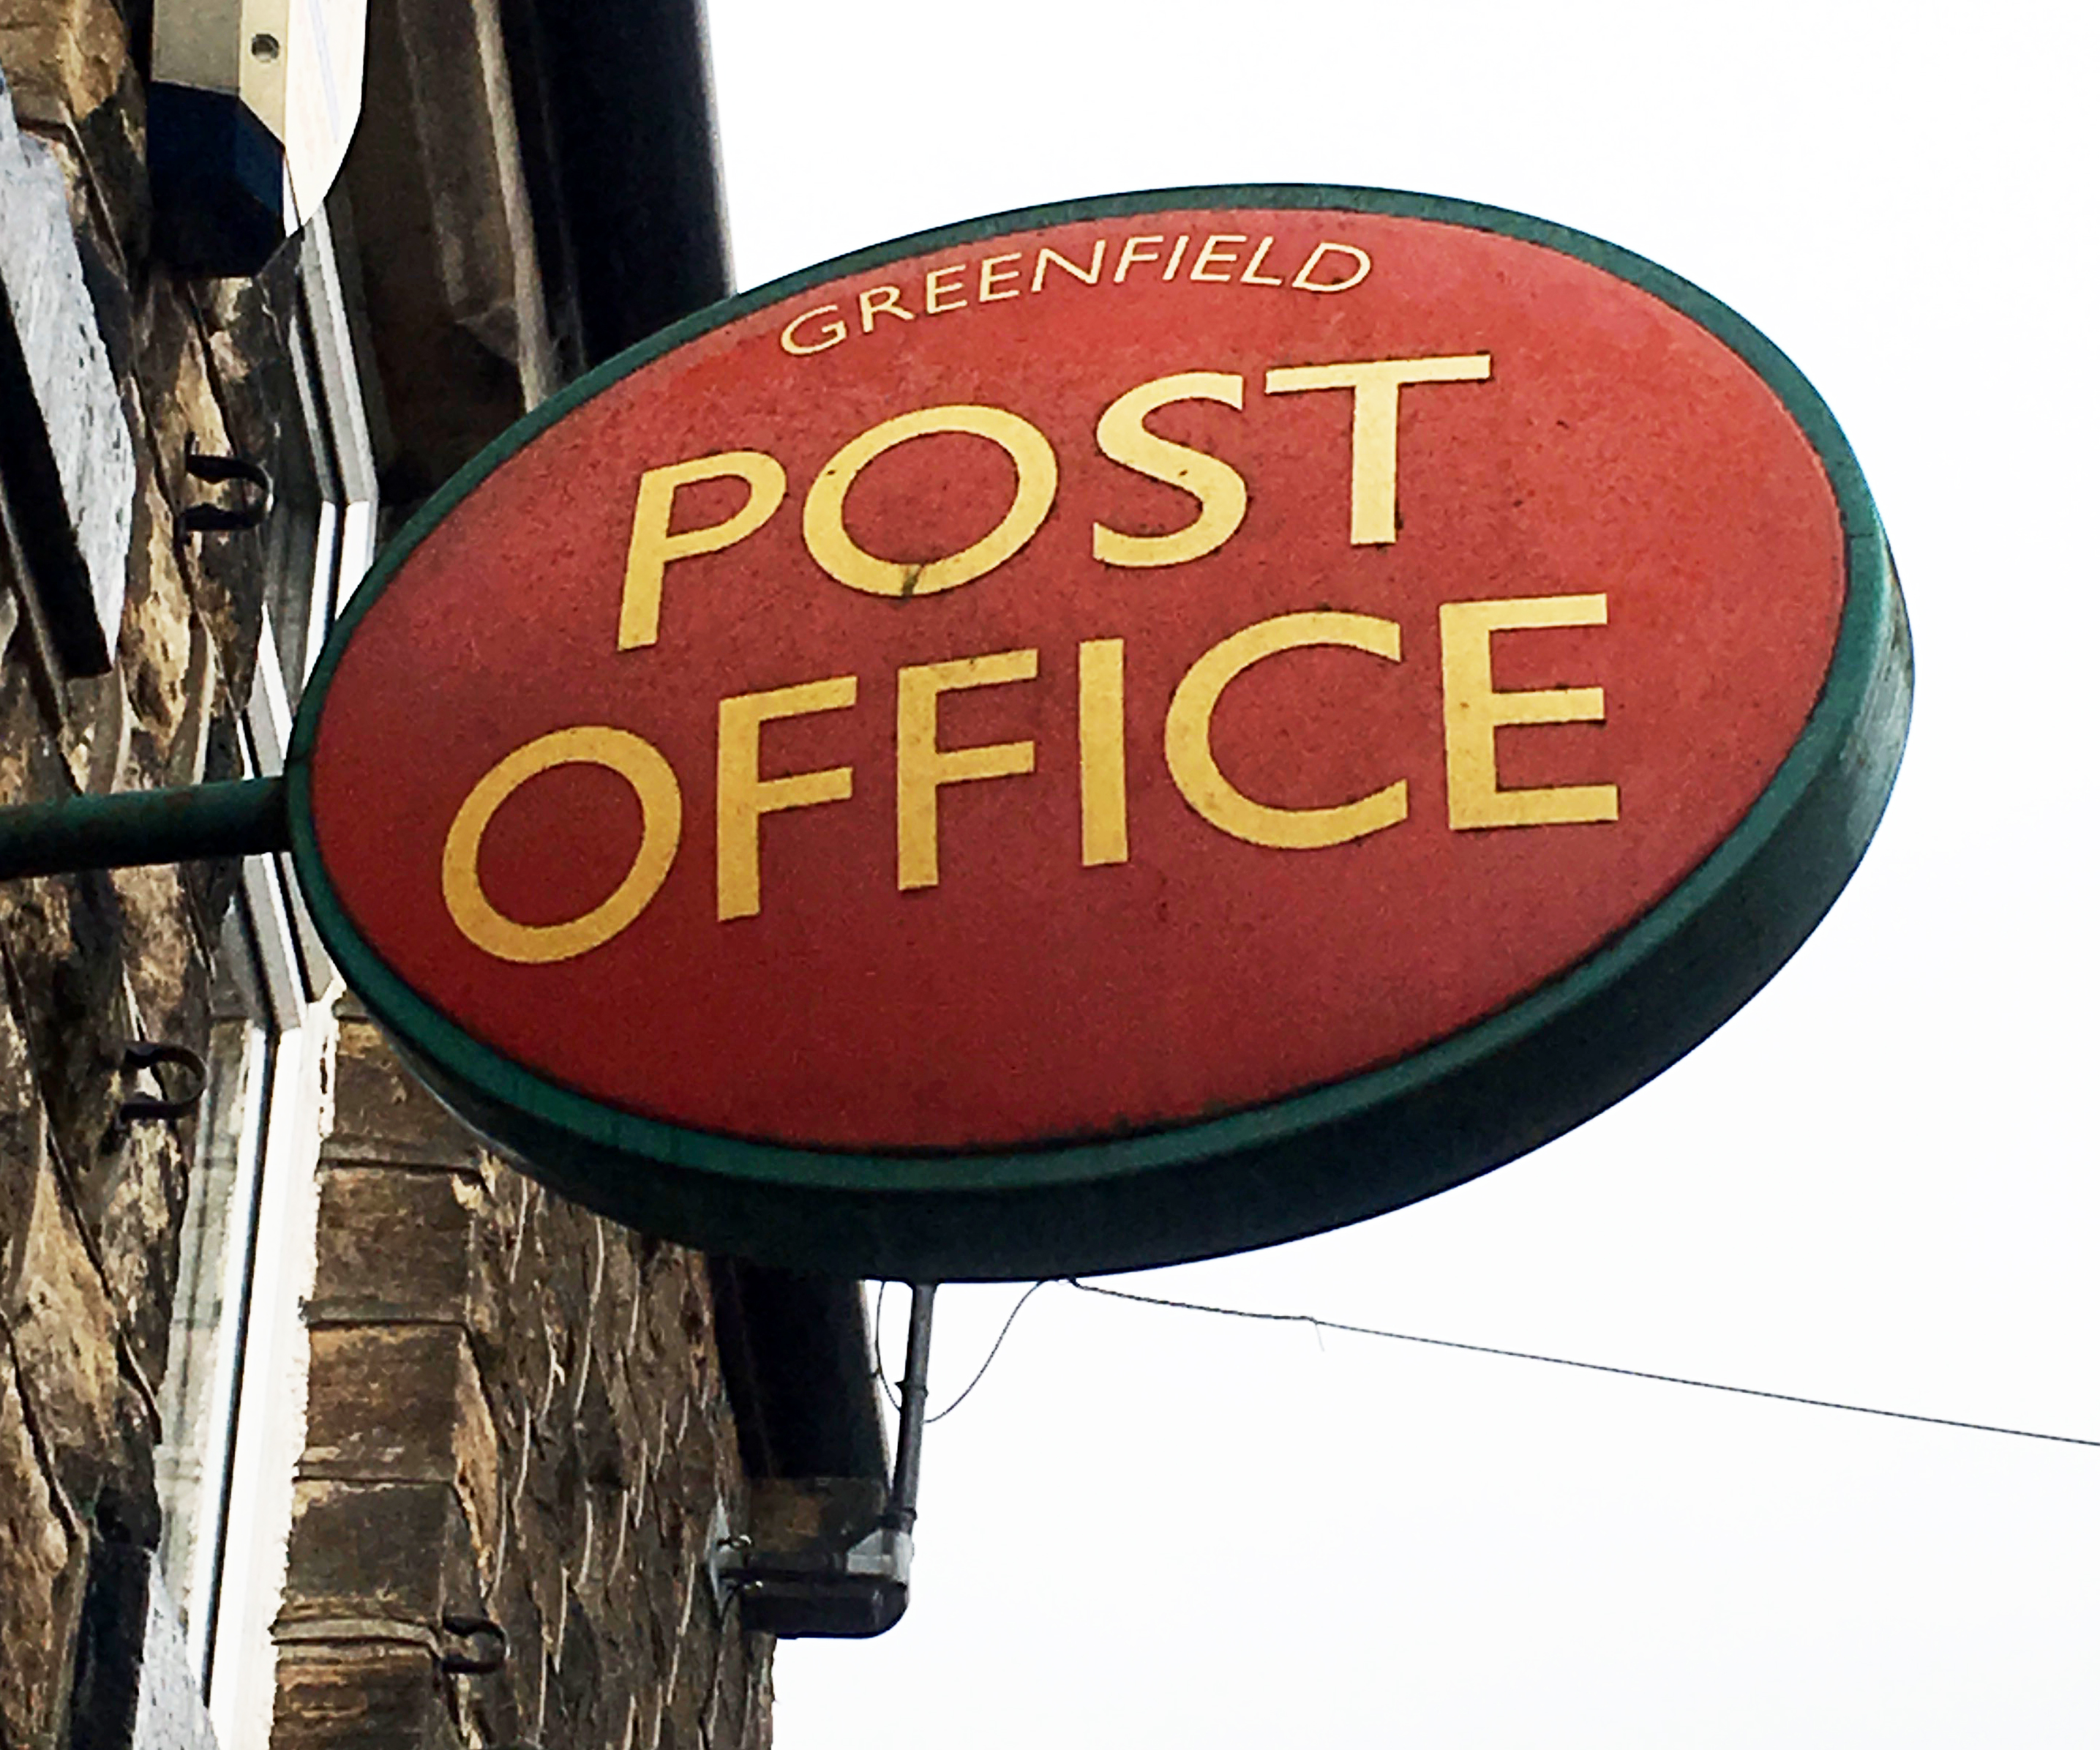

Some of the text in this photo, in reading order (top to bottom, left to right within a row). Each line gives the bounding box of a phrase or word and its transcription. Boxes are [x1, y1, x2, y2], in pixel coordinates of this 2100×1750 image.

[779, 233, 1372, 357] GREENFIELD
[616, 354, 1492, 653] POST
[440, 591, 1621, 964] OFFICE
